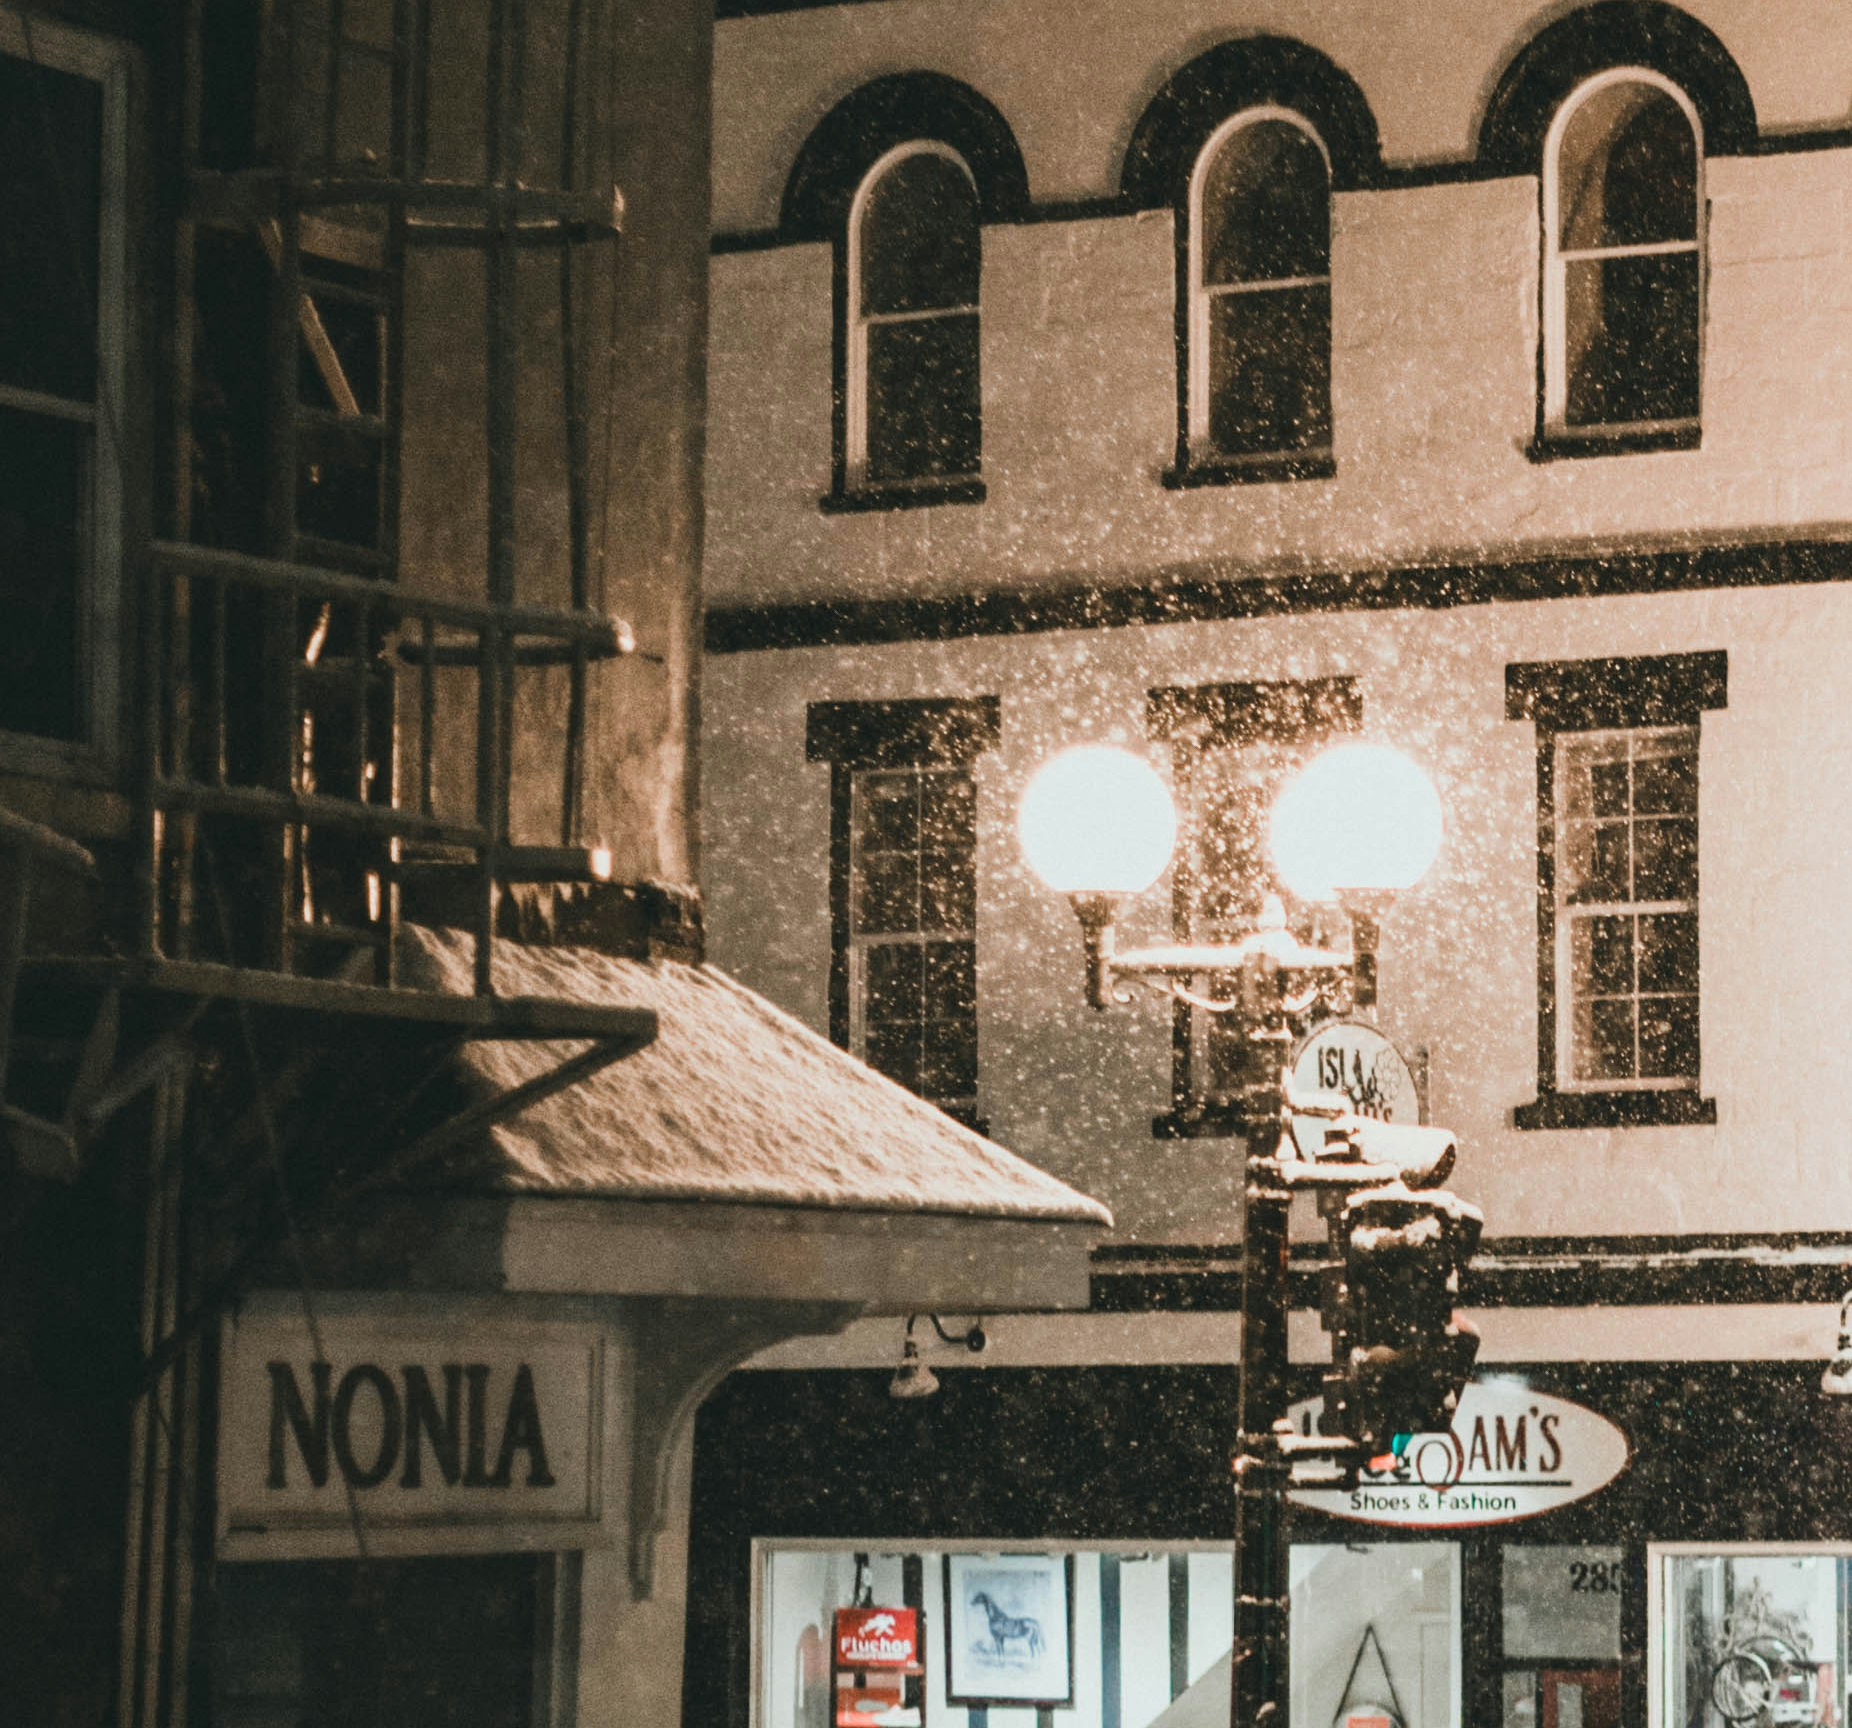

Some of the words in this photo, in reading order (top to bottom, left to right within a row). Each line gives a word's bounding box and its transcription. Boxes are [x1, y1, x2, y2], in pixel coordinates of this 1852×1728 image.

[265, 1360, 556, 1490] NONIA
[1350, 1491, 1411, 1511] Shoes
[1417, 1492, 1429, 1511] &
[1437, 1489, 1517, 1511] Fashion
